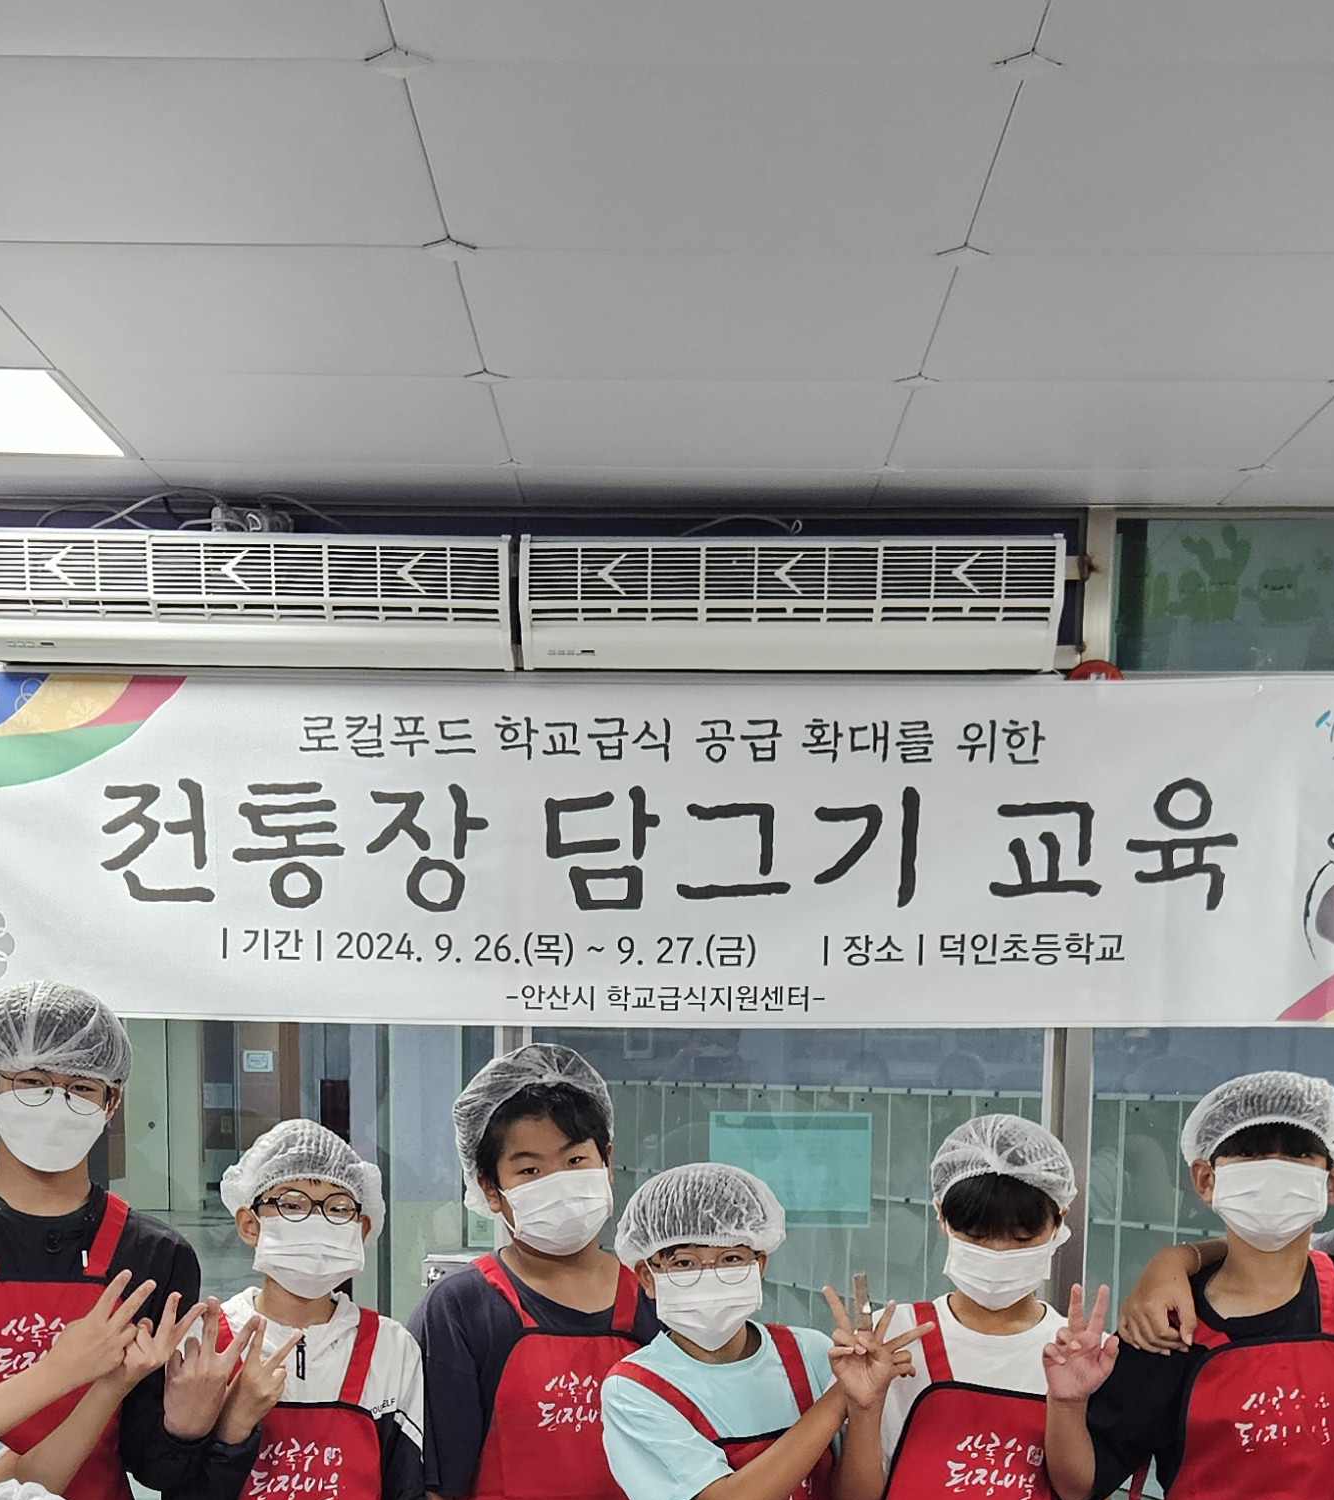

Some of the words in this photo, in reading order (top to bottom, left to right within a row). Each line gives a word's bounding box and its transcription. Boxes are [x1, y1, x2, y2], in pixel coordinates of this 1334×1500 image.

[300, 714, 476, 758] 로컬푸드
[495, 716, 670, 762] 학교급식
[696, 719, 782, 763] 공급
[802, 719, 933, 763] 확대를
[957, 720, 1045, 764] 위한
[101, 779, 489, 912] 전통장
[545, 786, 920, 910] 담그기
[989, 778, 1238, 910] 교육
[243, 929, 303, 960] 기간
[337, 932, 422, 962] 2024.
[435, 934, 461, 963] 9.
[475, 932, 573, 967] 26.(목)
[618, 936, 643, 965] 9.
[657, 934, 755, 968] 27.(금)
[843, 935, 904, 966] 장소
[940, 933, 1124, 965] 덕인초등학교
